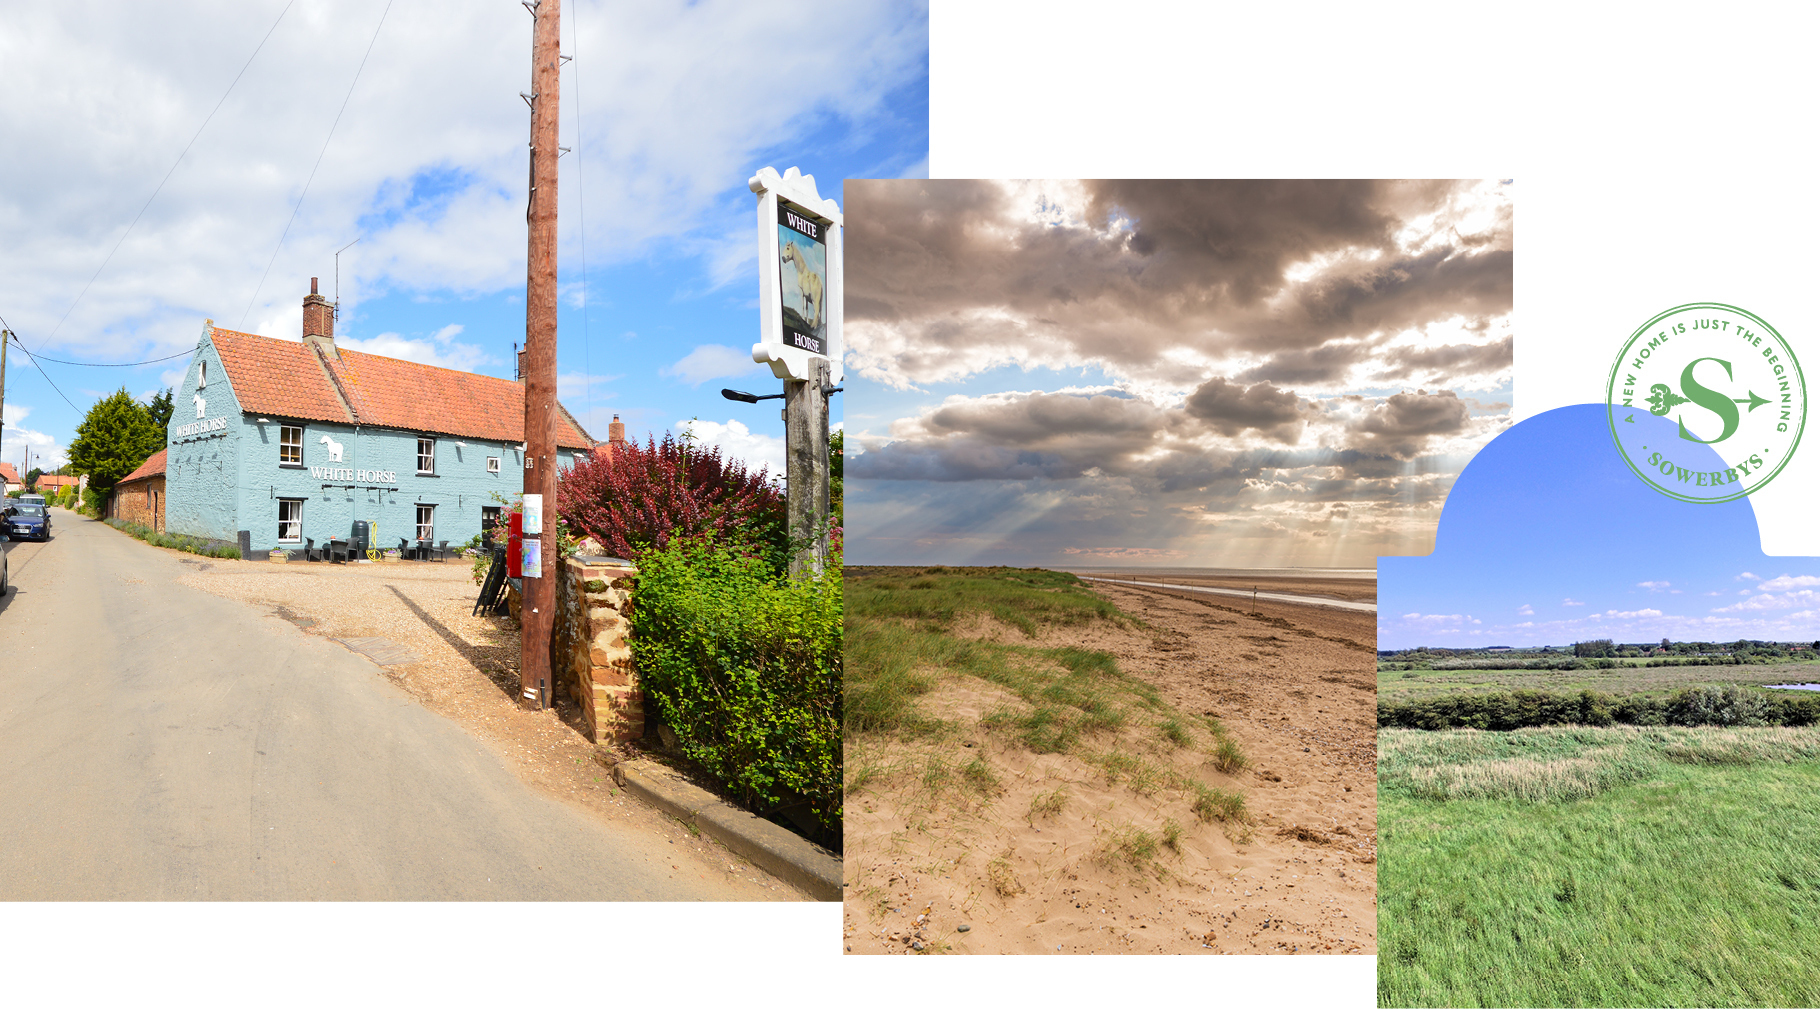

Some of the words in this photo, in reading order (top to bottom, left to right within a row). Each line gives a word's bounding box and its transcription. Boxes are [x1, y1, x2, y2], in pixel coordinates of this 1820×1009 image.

[787, 212, 817, 238] WHITE
[794, 332, 820, 354] HORSE
[176, 422, 200, 438] WHITE
[200, 416, 228, 434] HORSE
[310, 466, 354, 482] WHITE
[356, 469, 397, 484] HORSE
